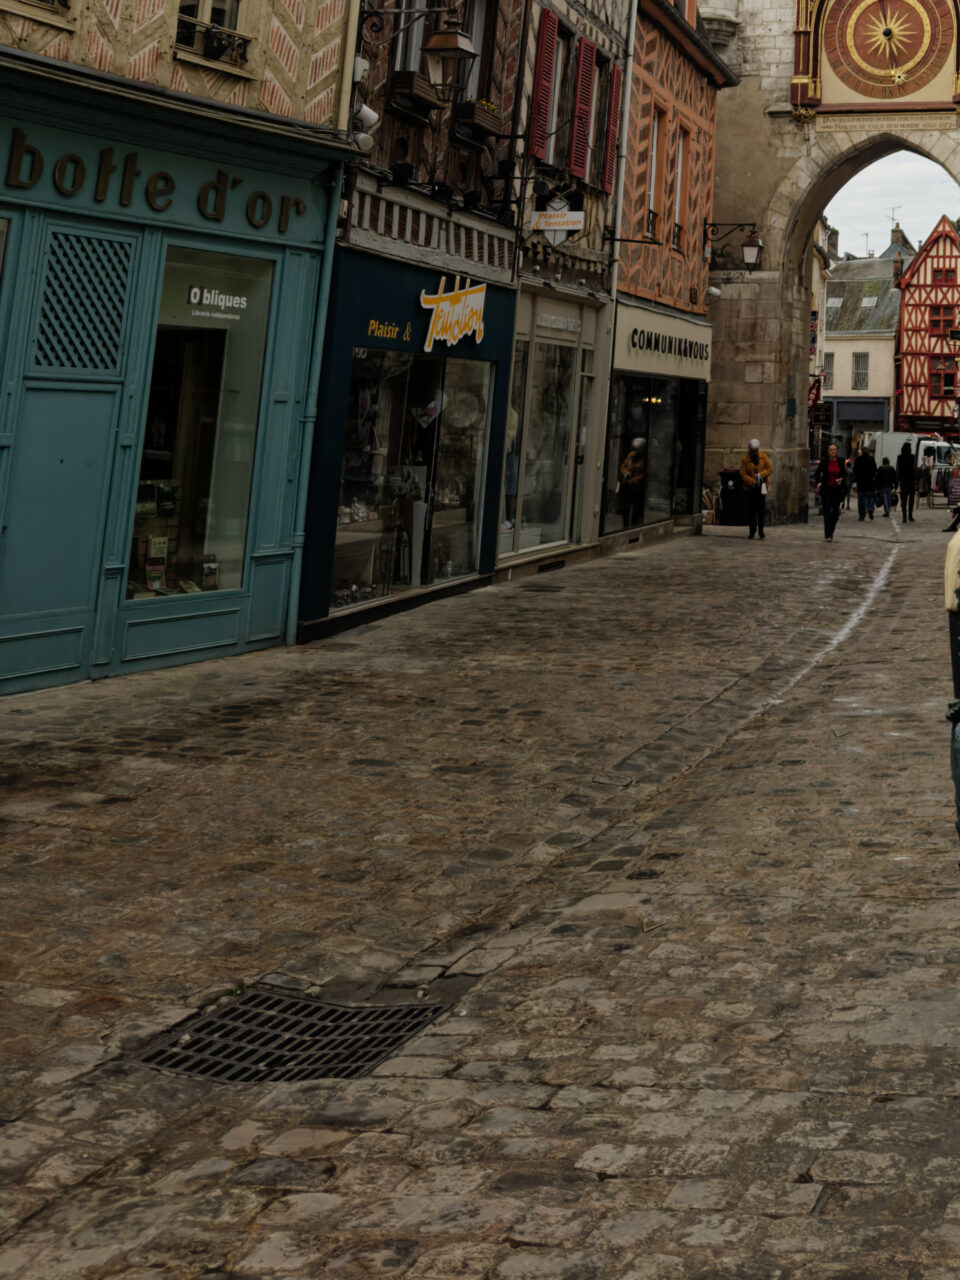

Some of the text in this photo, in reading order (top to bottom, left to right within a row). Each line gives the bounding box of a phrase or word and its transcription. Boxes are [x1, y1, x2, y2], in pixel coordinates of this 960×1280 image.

[6, 127, 307, 234] botte d'or
[537, 212, 568, 220] Plaisir
[543, 219, 582, 228] Tentation
[367, 319, 400, 340] Plaisir
[402, 321, 412, 342] &
[631, 328, 709, 360] COMMUNIK&VOUS
